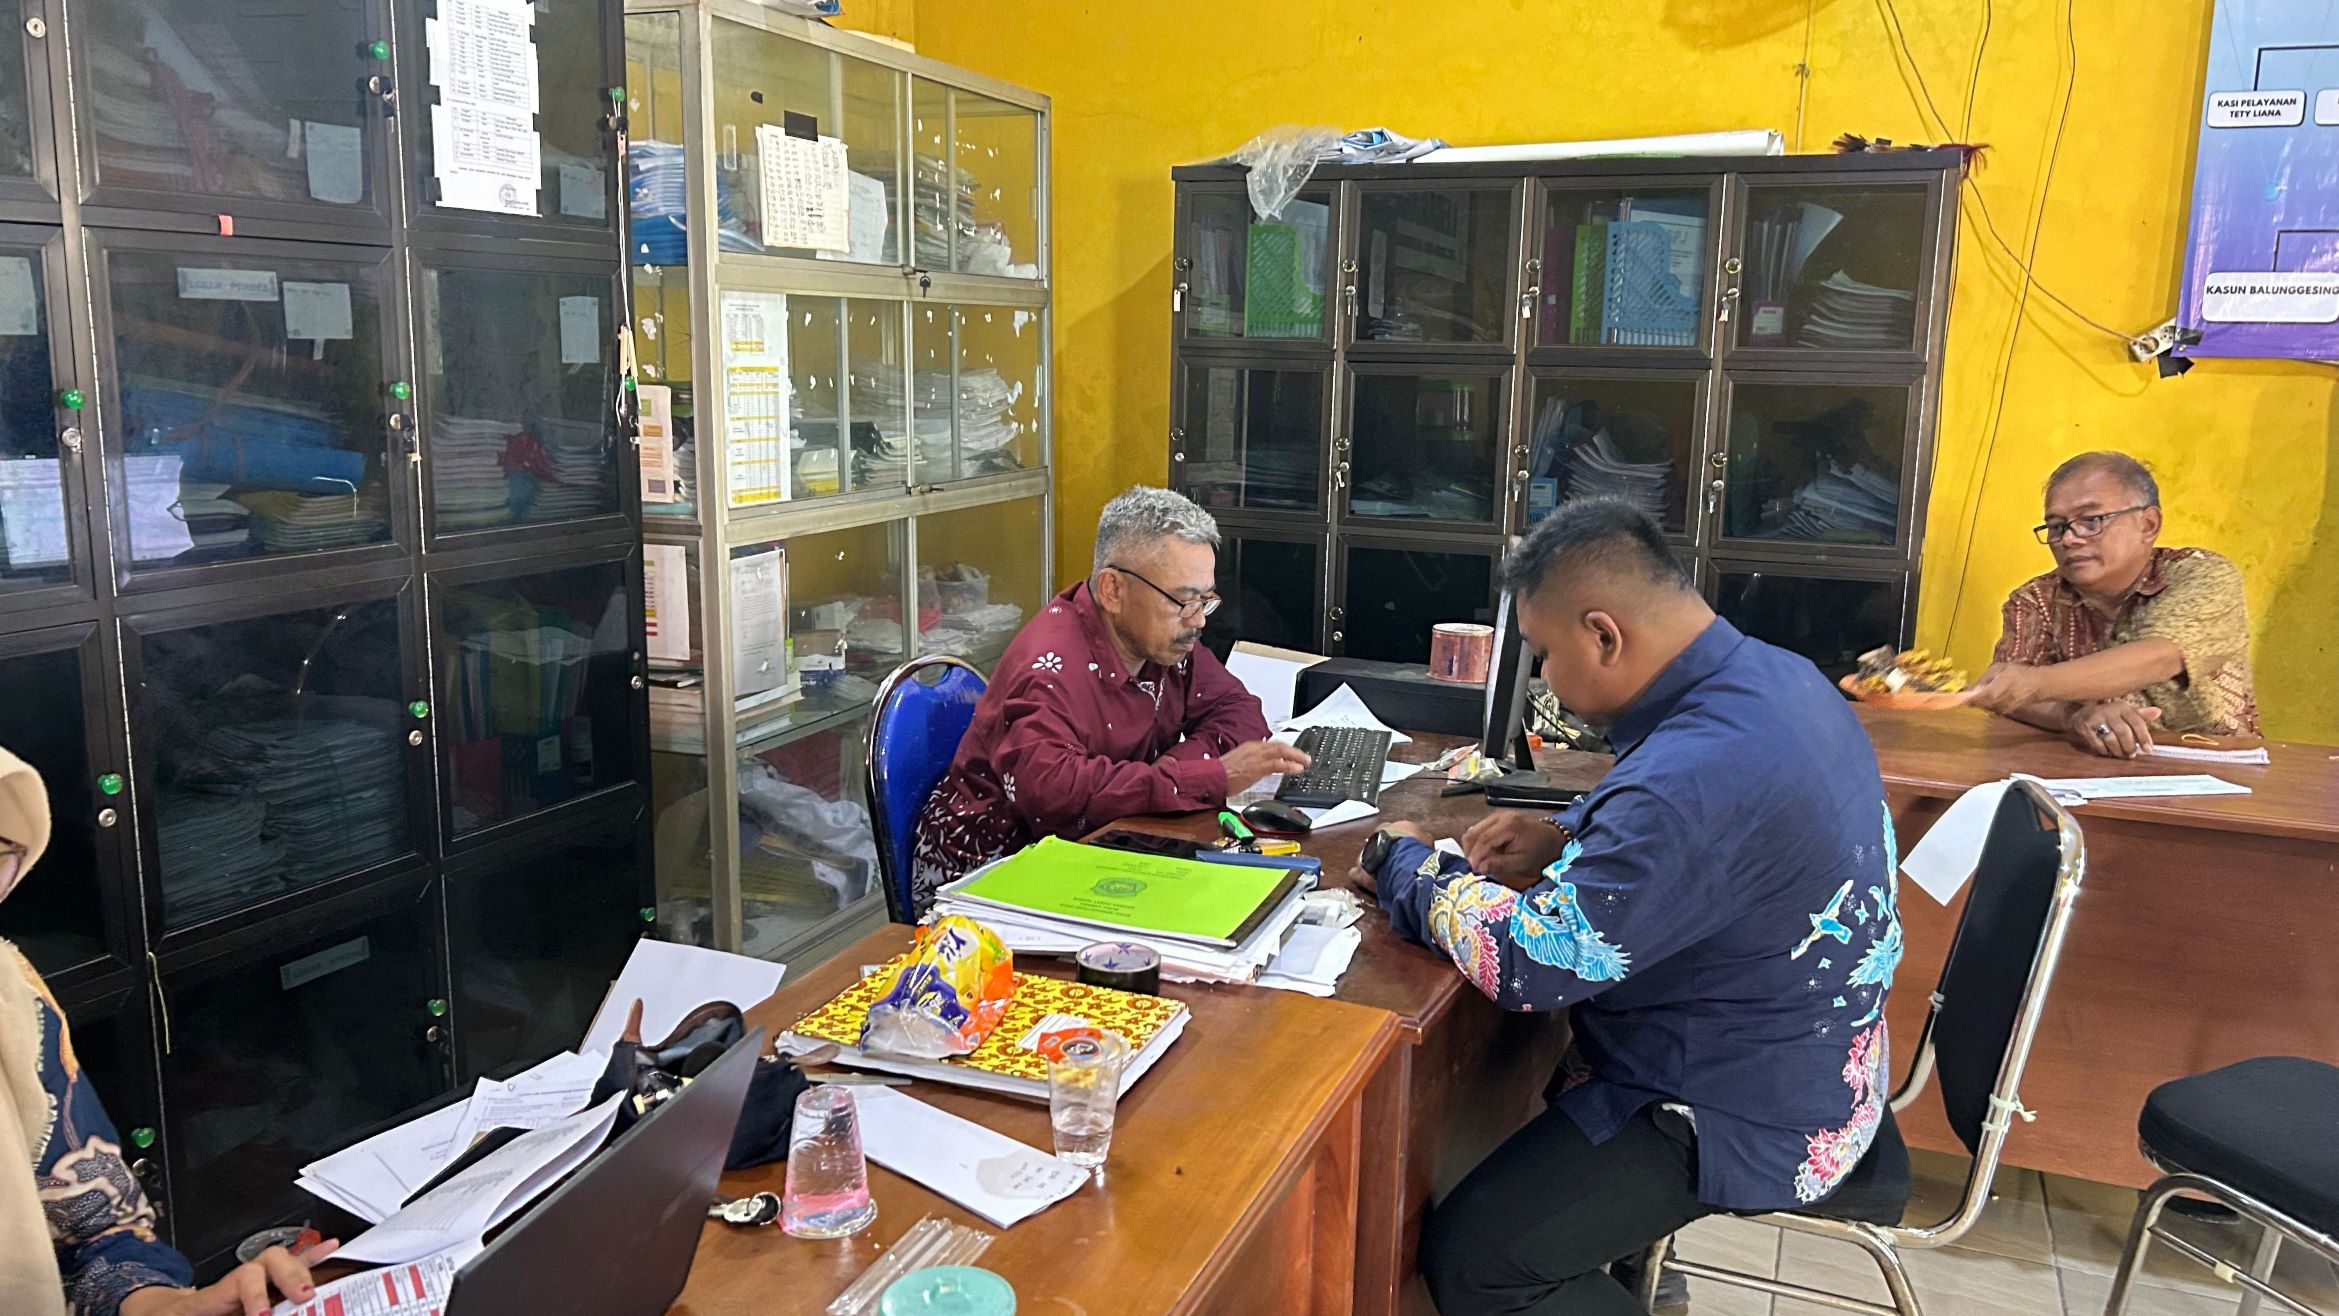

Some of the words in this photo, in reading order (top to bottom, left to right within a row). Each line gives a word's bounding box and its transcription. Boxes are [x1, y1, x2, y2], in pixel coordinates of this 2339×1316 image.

[2217, 99, 2239, 108] KASI
[2240, 98, 2297, 107] PELAYANAN
[2229, 110, 2252, 118] TETY
[2253, 109, 2282, 117] LIANA
[2206, 285, 2247, 295] KASUN
[2249, 285, 2339, 296] BALUNGGESING
